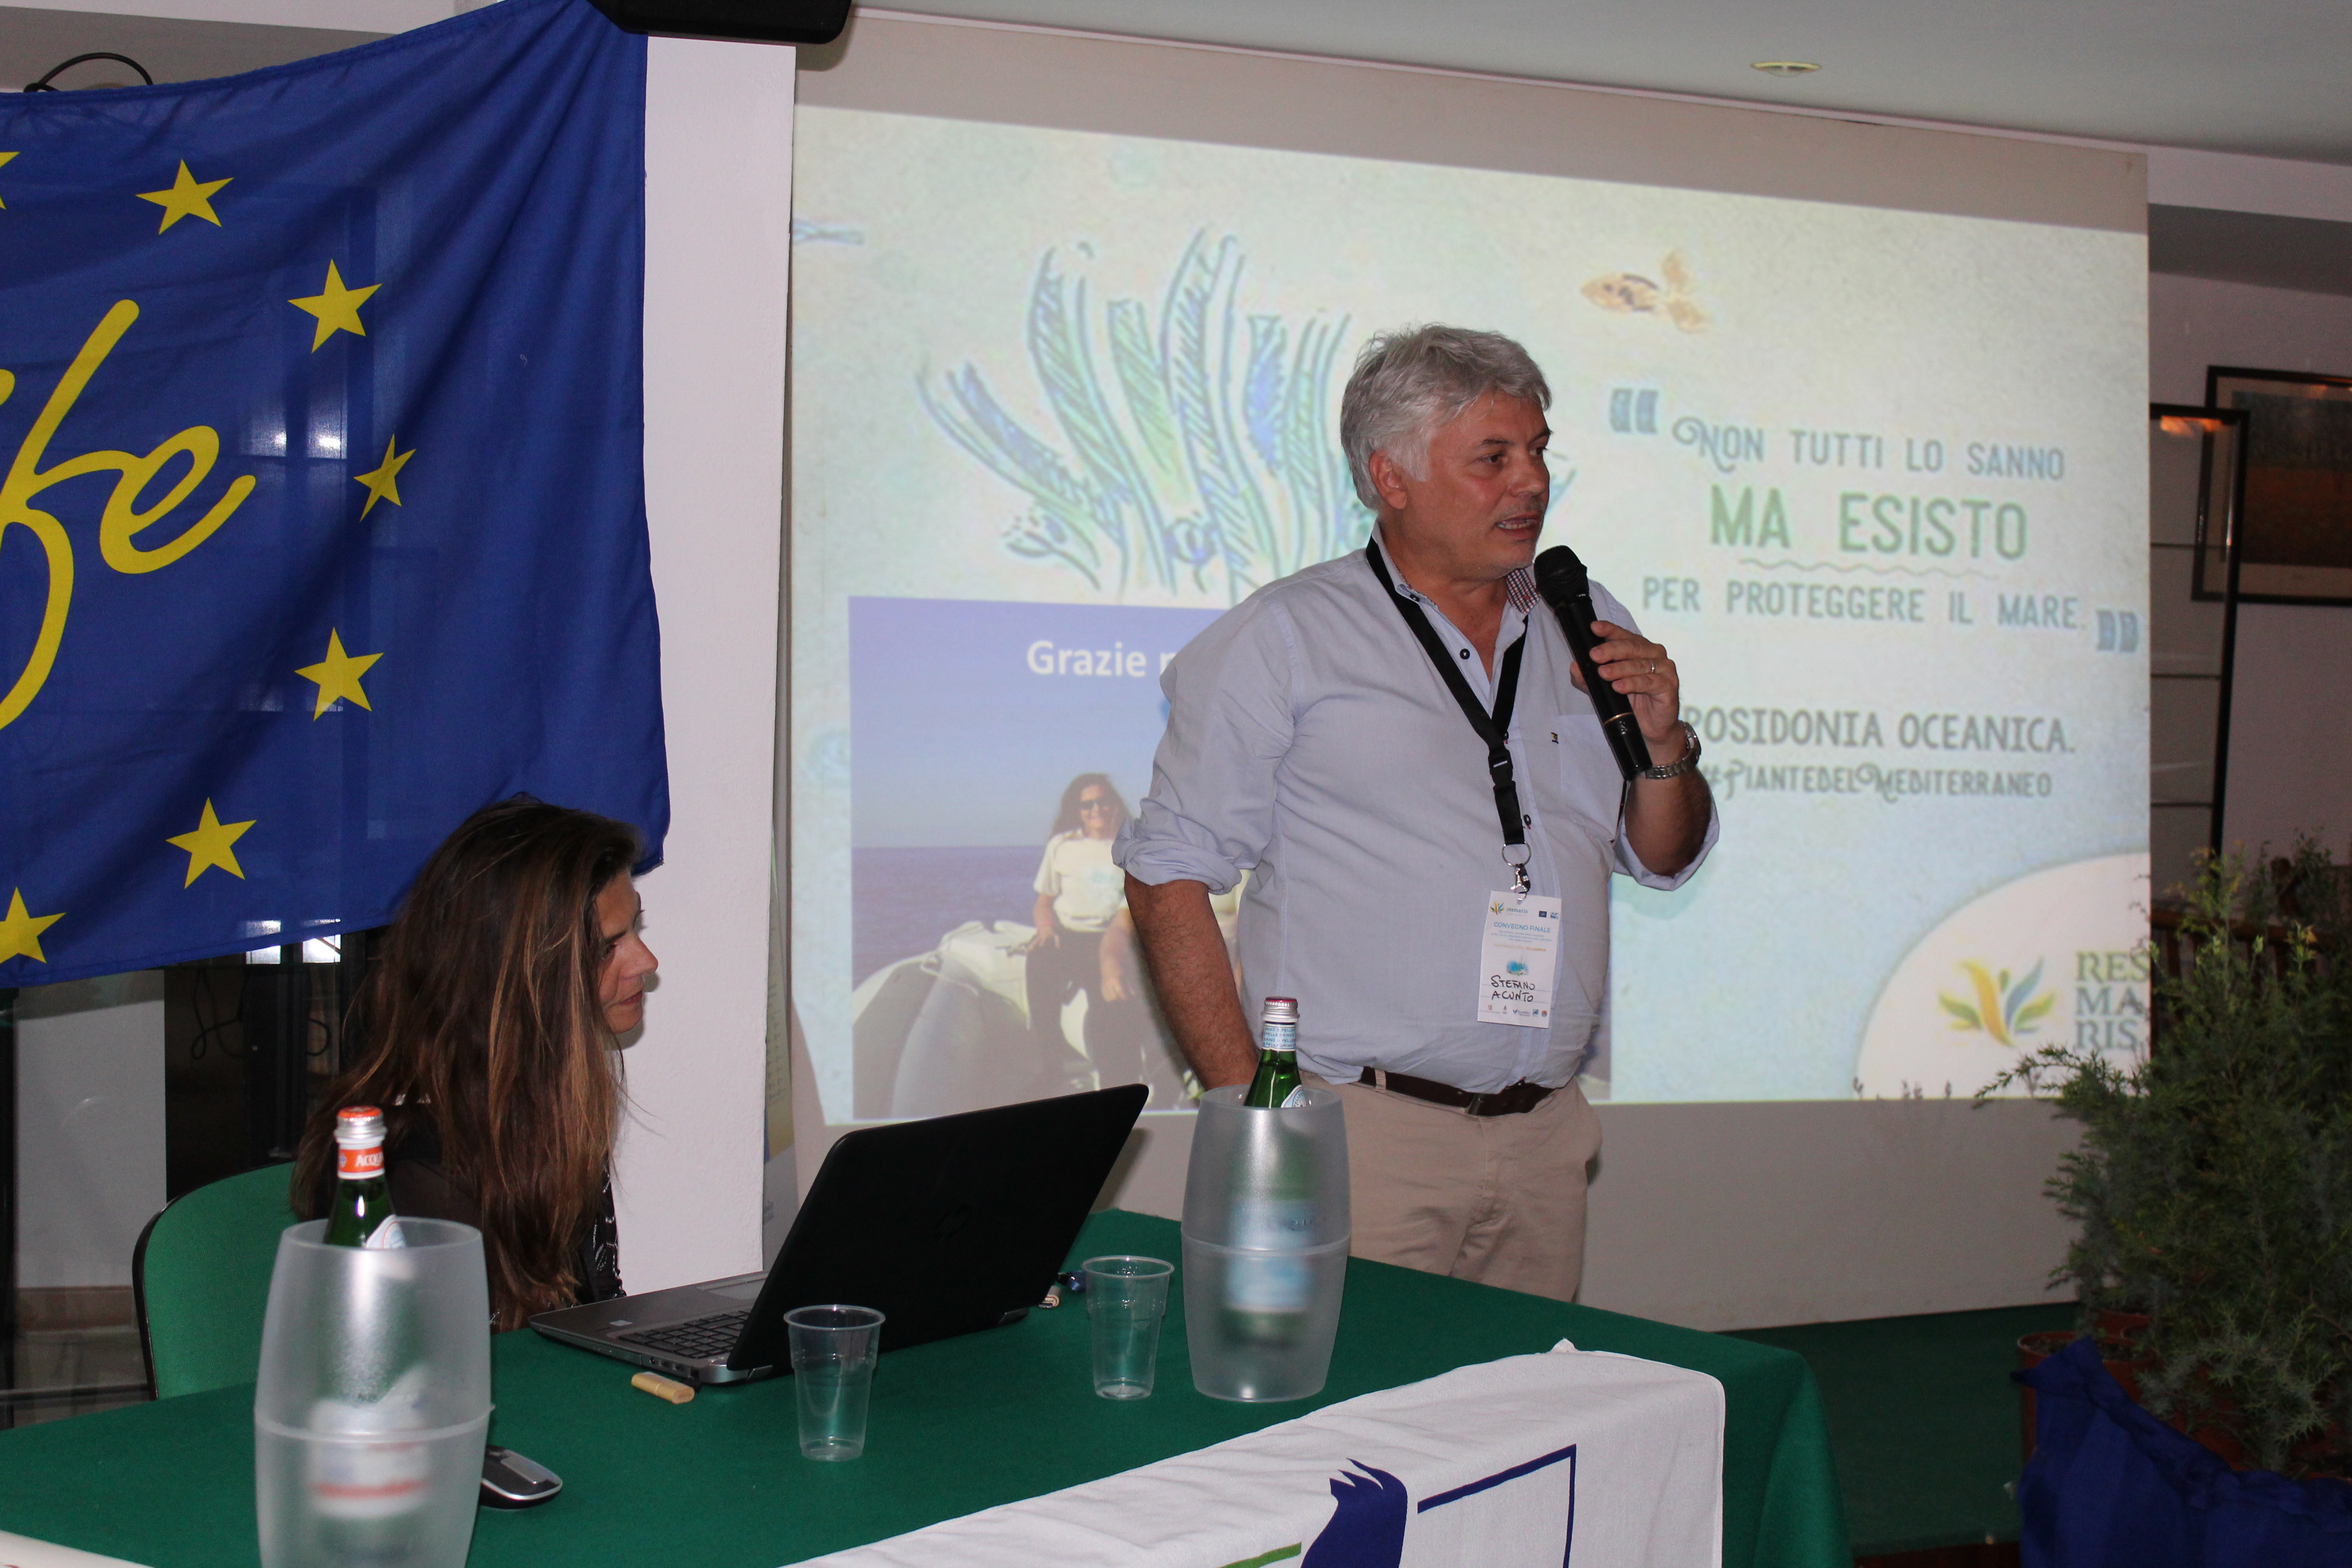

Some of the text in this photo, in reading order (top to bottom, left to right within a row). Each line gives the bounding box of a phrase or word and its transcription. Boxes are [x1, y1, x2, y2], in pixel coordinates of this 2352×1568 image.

[1672, 416, 2064, 481] NON TUTTI LO SANNO
[1711, 483, 2027, 560] MA ESISTO
[1642, 576, 1700, 612] PER
[1726, 580, 1926, 622] PROTEGGERE
[1950, 591, 1974, 624] IL
[1027, 640, 1147, 677] Grazie
[1683, 706, 1884, 748] POSIDONIA
[1494, 922, 1528, 930] CONVEGNO
[2076, 951, 2151, 983] RES
[1491, 990, 1534, 1002] ACUNTO
[2076, 986, 2144, 1015] MA
[2076, 1019, 2137, 1050] RIS
